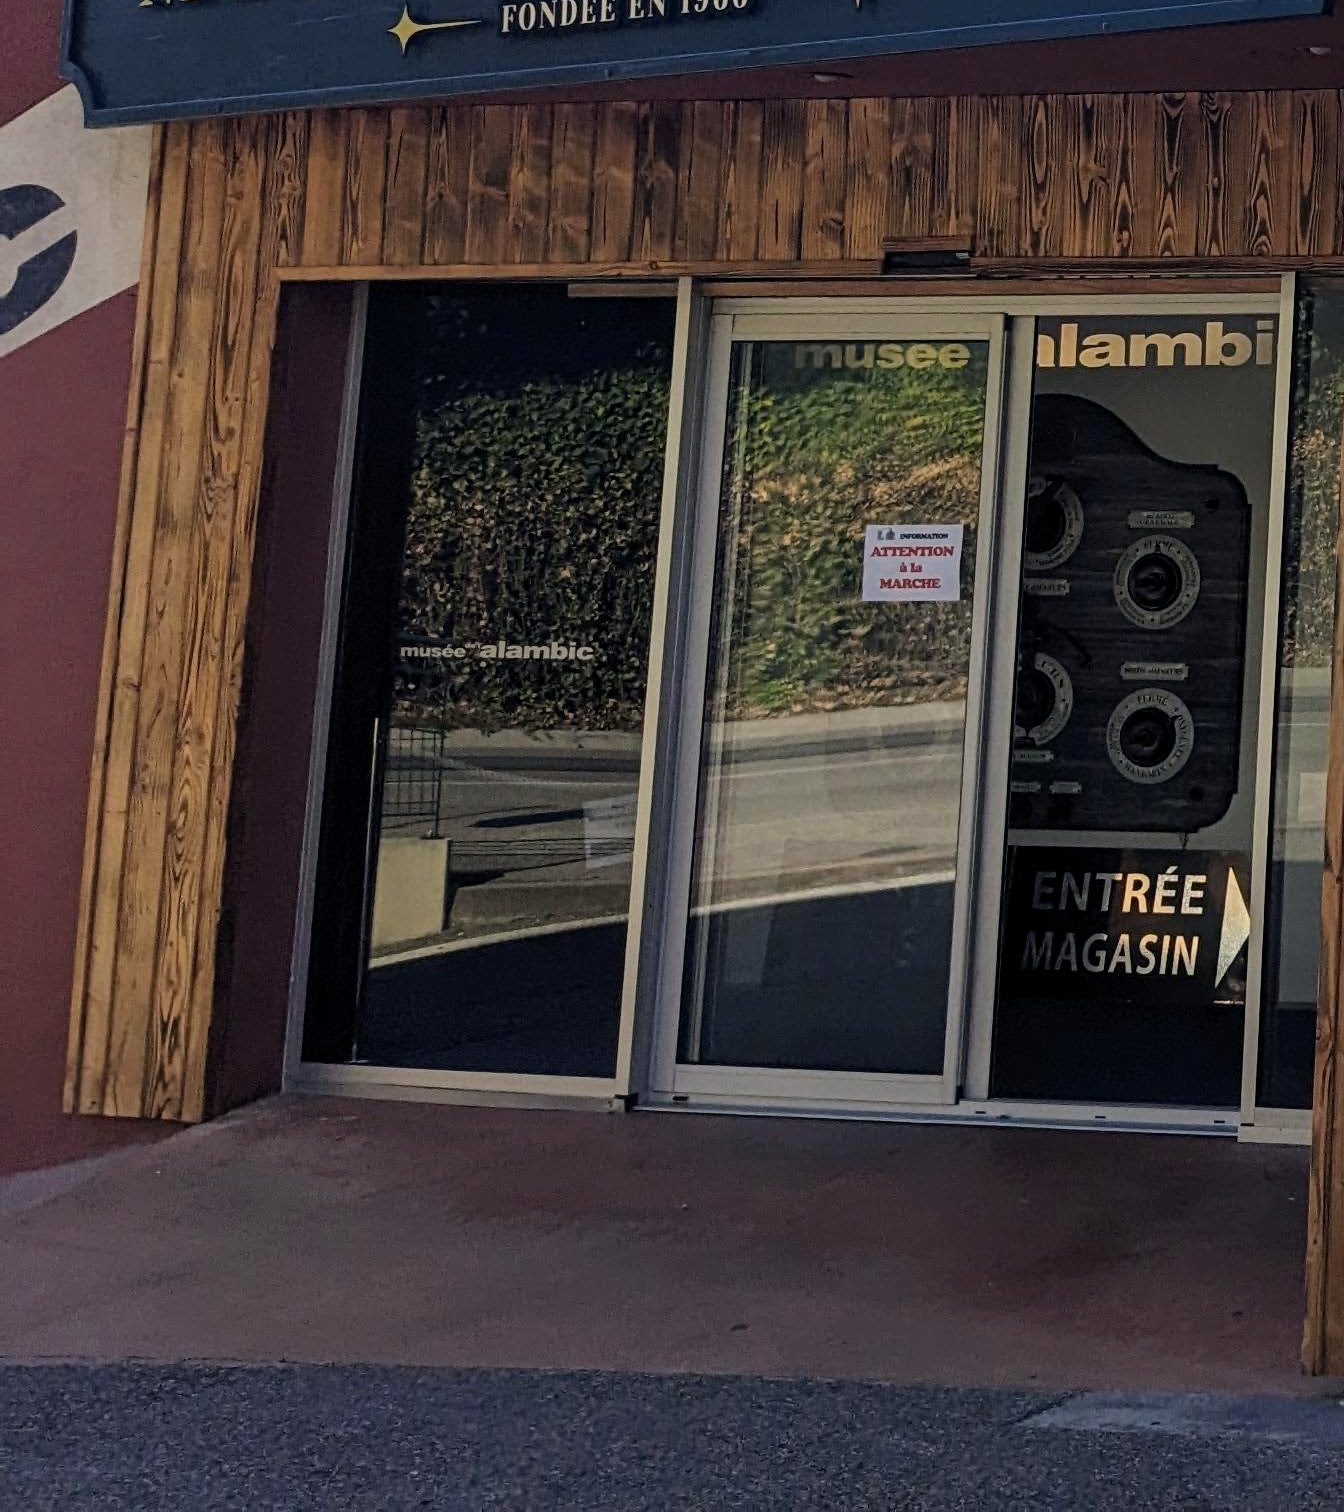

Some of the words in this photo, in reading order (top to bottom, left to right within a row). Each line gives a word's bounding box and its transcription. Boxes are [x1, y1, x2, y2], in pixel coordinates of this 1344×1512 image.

[870, 546, 955, 557] ATTENTION
[880, 578, 942, 589] MARCHE
[400, 643, 467, 658] musée
[480, 641, 595, 660] alambic
[1031, 865, 1207, 915] ENTRÉE
[1020, 931, 1200, 976] MAGASIN
